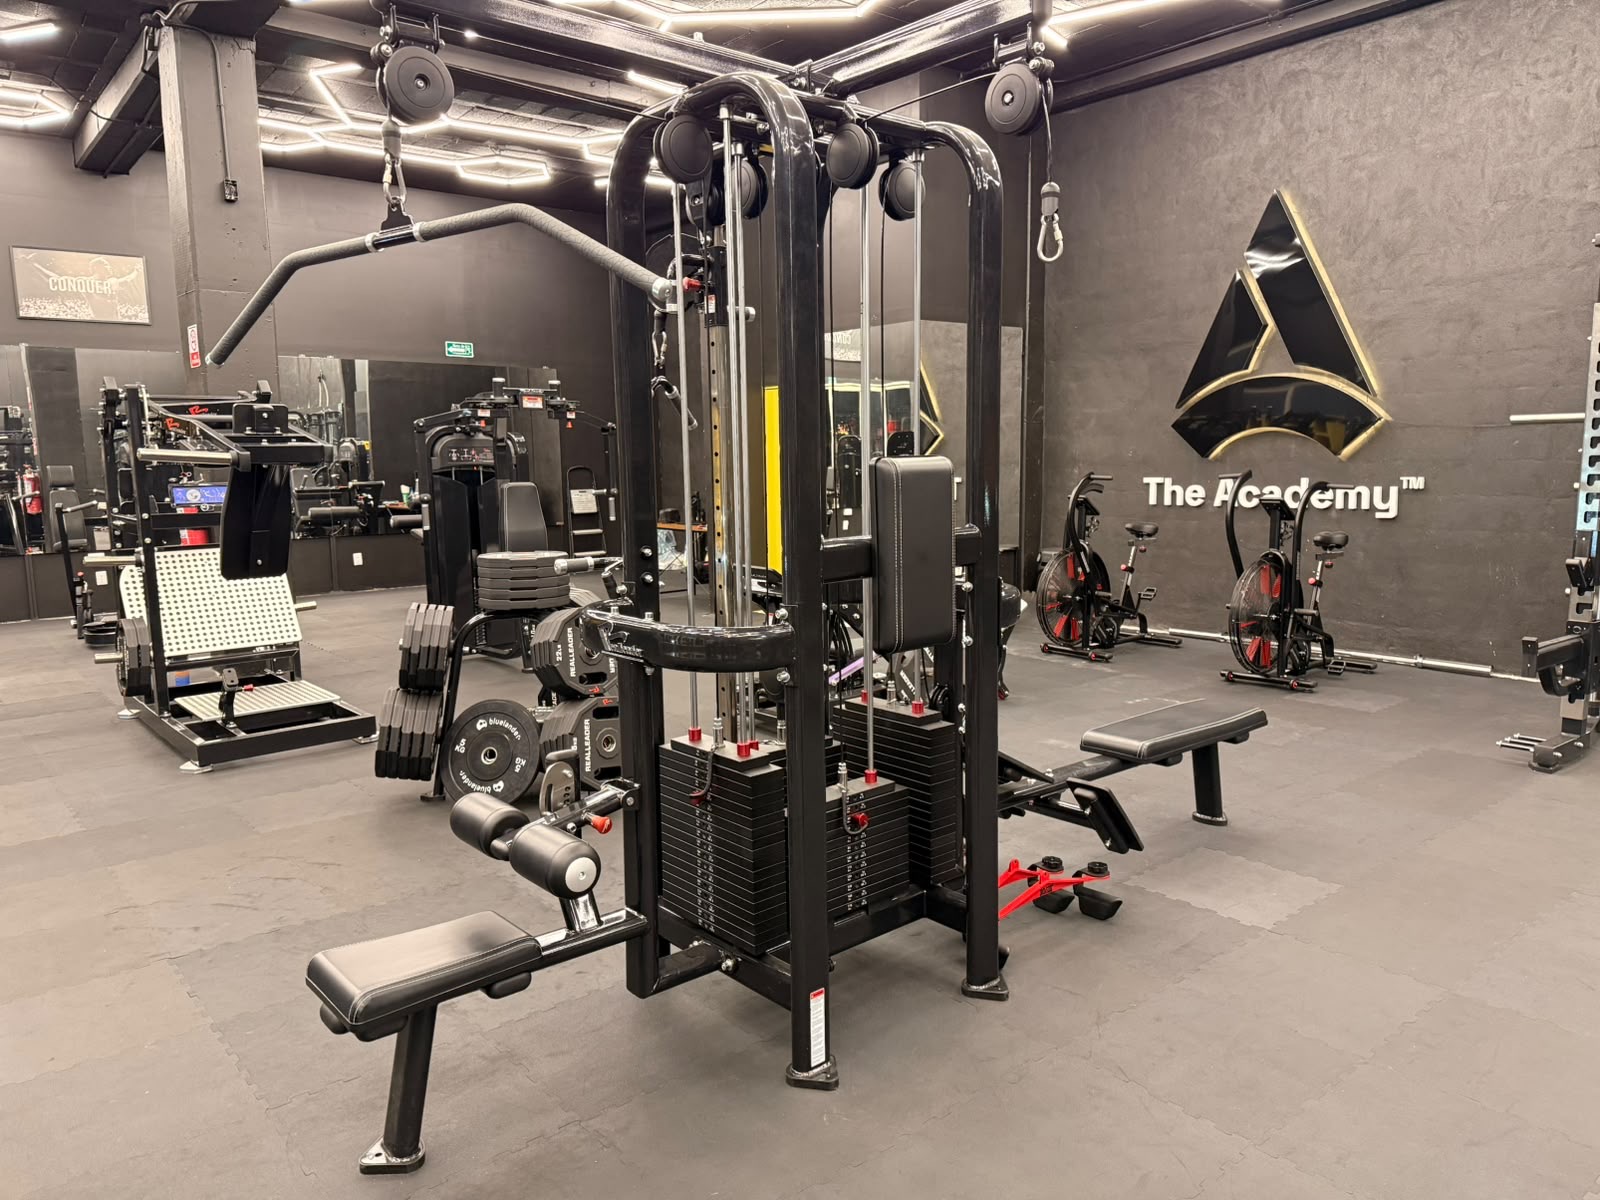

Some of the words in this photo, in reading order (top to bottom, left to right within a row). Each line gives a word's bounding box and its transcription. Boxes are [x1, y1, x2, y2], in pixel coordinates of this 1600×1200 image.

[48, 276, 115, 295] CONQUER.
[1143, 477, 1205, 506] The
[567, 627, 577, 677] REALLEADER
[489, 717, 521, 740] bluelander
[584, 718, 592, 772] REALLEADER
